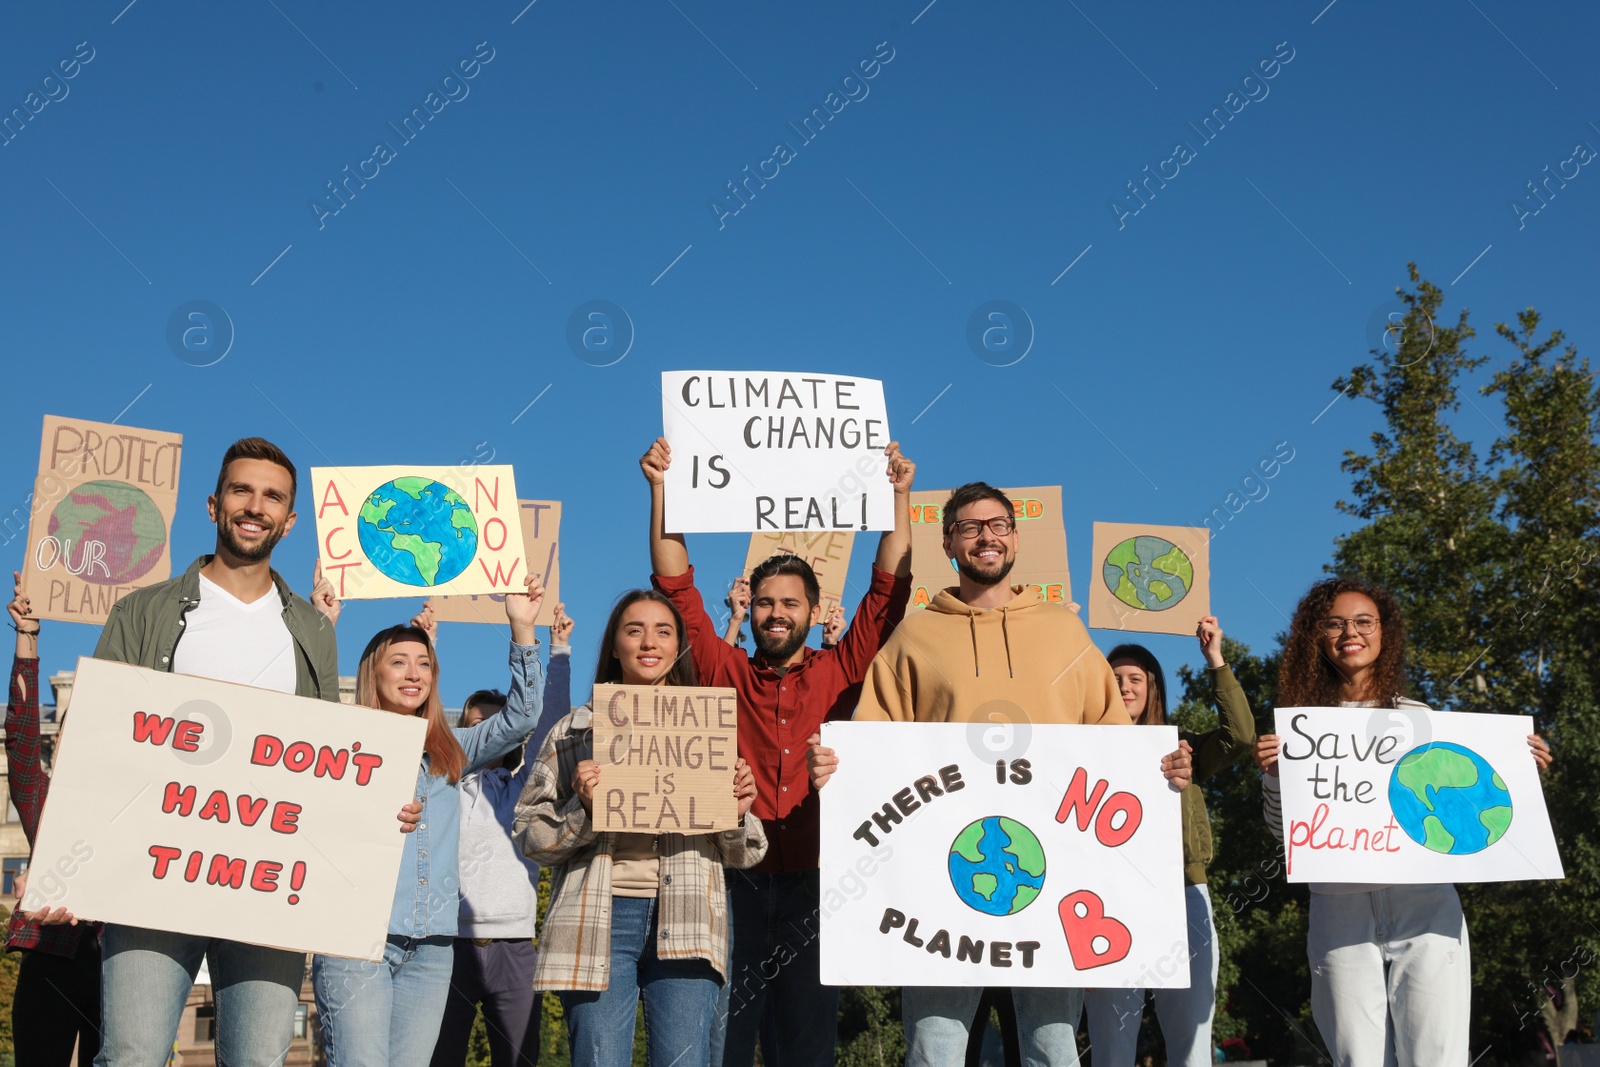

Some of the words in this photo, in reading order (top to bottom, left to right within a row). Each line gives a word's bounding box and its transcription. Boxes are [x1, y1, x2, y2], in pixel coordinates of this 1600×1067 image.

[682, 376, 860, 410] CLIMATE
[51, 425, 182, 490] PROTECT
[743, 415, 886, 450] CHANGE
[692, 454, 731, 489] IS
[319, 480, 362, 597] ACT
[475, 476, 519, 593] NOW
[755, 493, 869, 531] REAL!
[36, 536, 110, 578] OUR
[132, 711, 205, 752] WE
[250, 733, 383, 787] DON'T
[608, 734, 729, 772] CHANGE
[1282, 713, 1398, 765] Save
[161, 781, 302, 835] HAVE
[606, 788, 715, 830] REAL
[852, 763, 965, 848] THERE
[995, 758, 1033, 786] IS
[1055, 767, 1143, 848] NO
[1306, 762, 1377, 804] the
[1287, 802, 1401, 876] planet
[148, 845, 307, 906] TIME!
[879, 907, 1041, 969] PLANET
[1058, 889, 1133, 971] B
